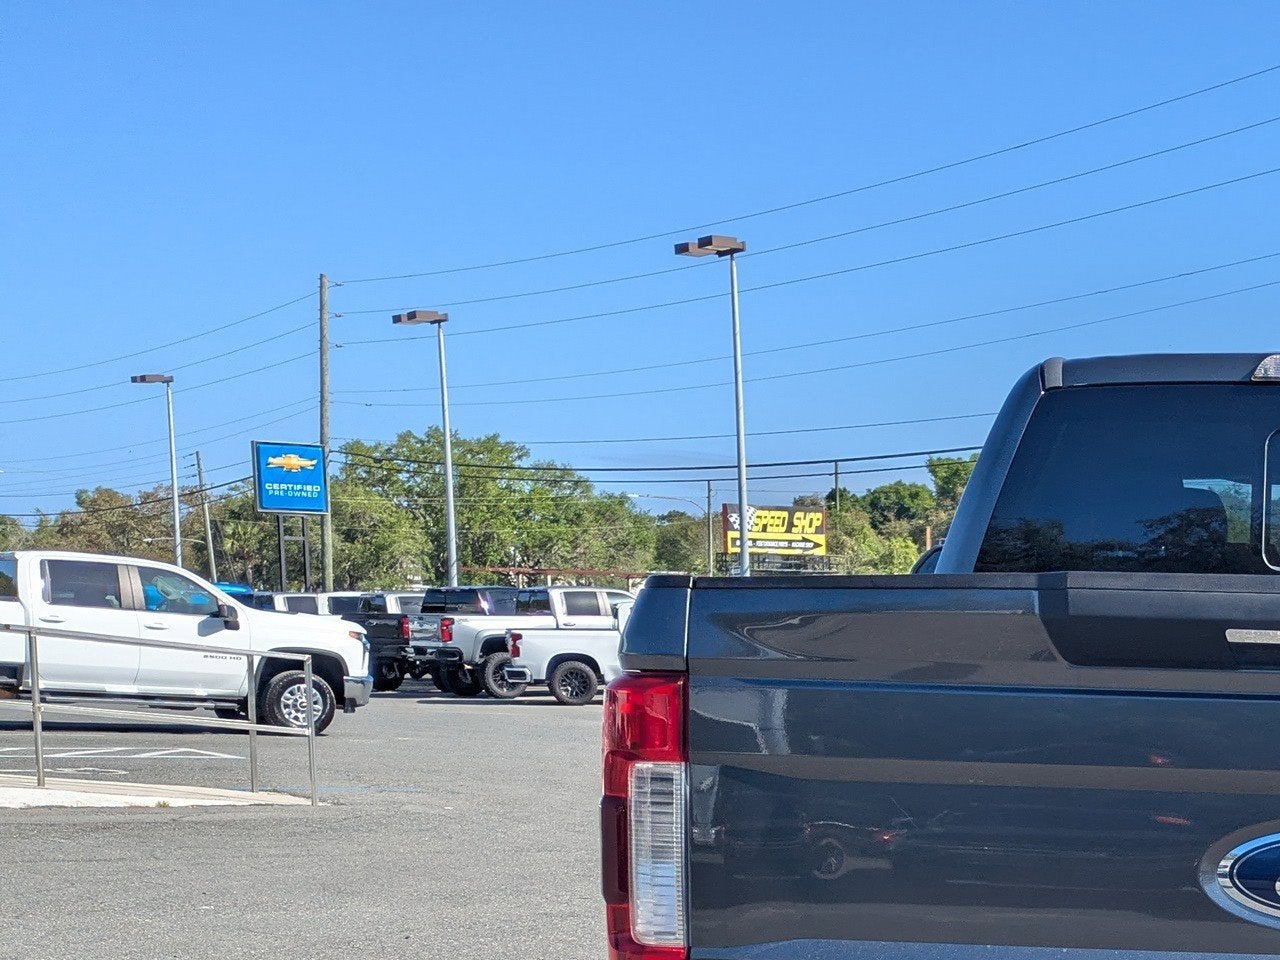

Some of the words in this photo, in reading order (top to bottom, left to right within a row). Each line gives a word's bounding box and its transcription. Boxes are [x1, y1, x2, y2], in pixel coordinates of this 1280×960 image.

[265, 483, 321, 492] CERTIFIED
[268, 490, 319, 498] PRE-OWNED
[751, 509, 789, 533] SPEED
[791, 511, 823, 534] SHOP
